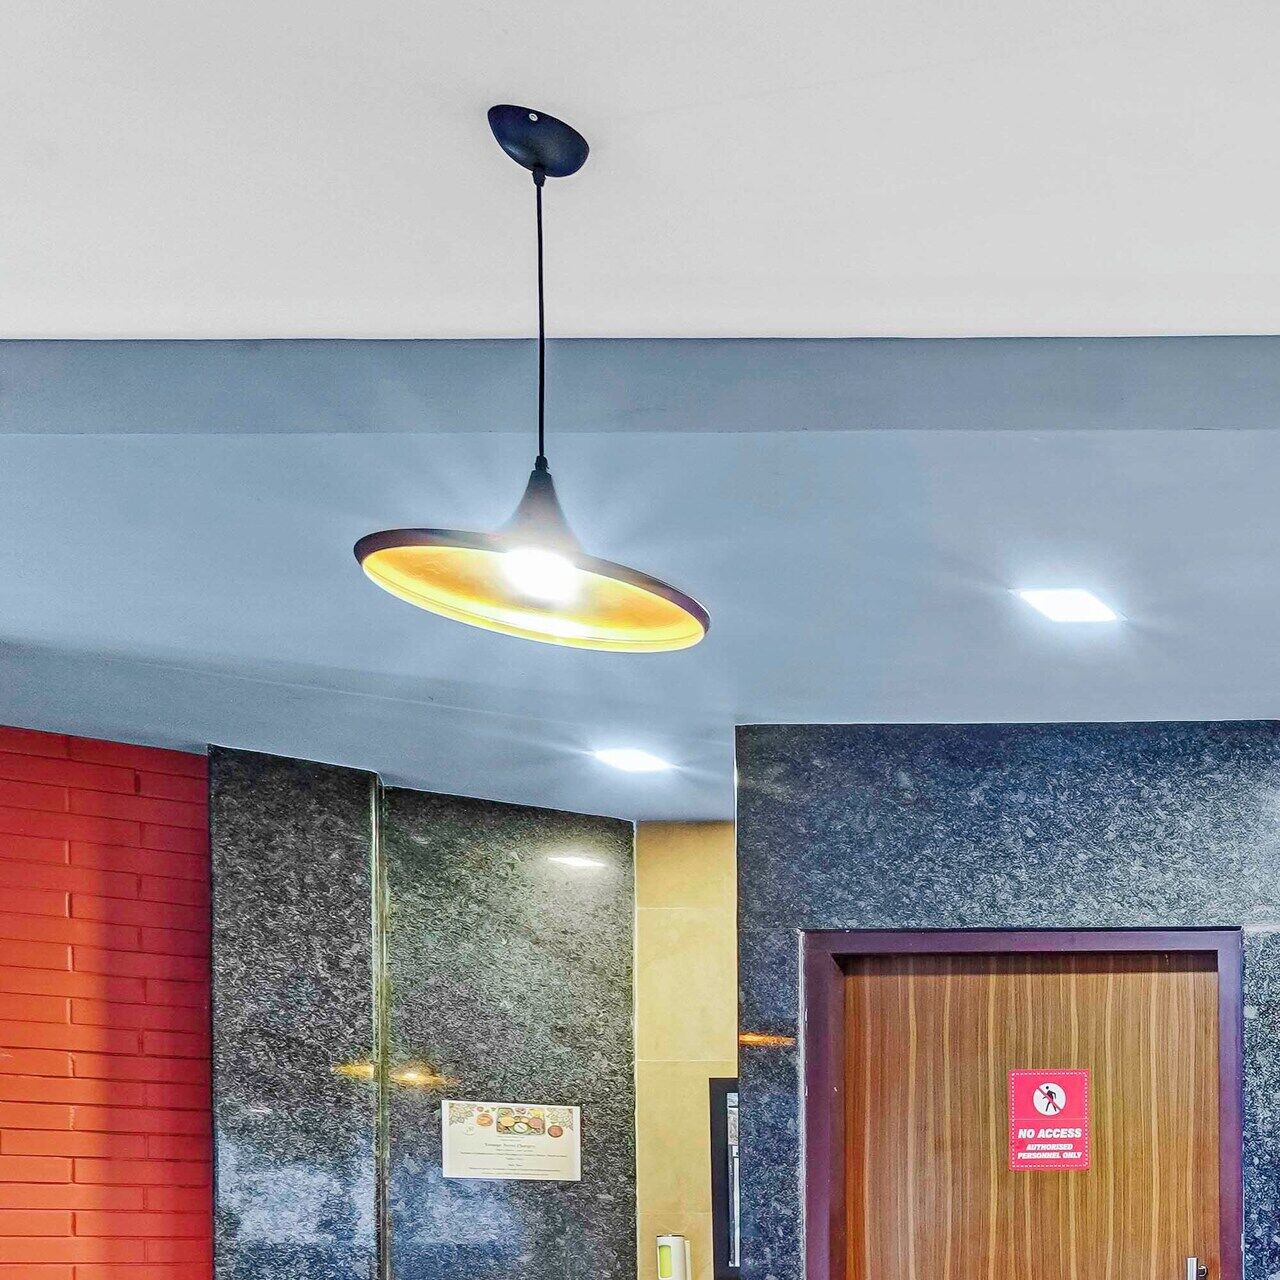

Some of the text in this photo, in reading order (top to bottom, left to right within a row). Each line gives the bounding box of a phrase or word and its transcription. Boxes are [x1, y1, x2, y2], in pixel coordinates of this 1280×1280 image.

[1017, 1128, 1082, 1139] NO ACCESS
[1017, 1152, 1062, 1160] PERSONNEL
